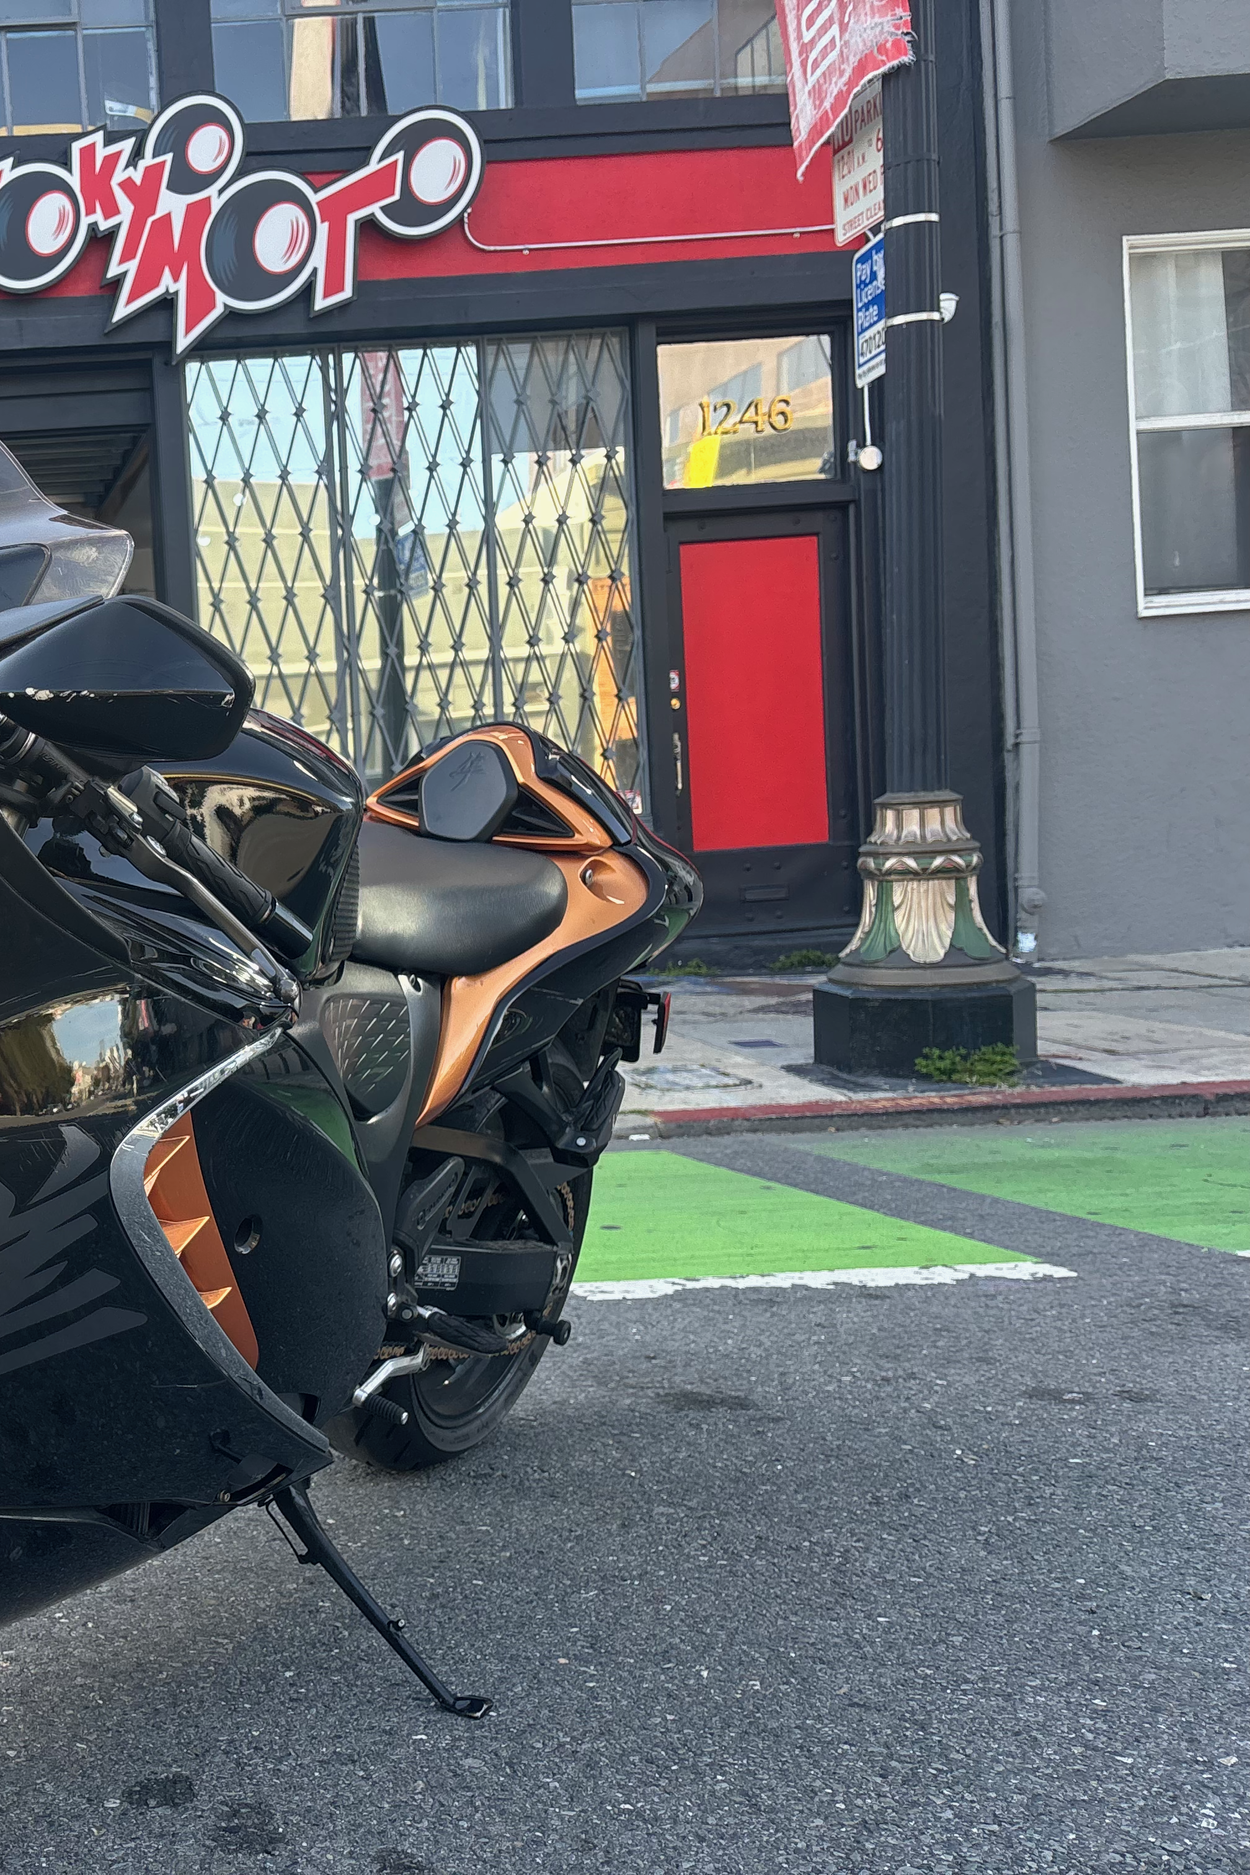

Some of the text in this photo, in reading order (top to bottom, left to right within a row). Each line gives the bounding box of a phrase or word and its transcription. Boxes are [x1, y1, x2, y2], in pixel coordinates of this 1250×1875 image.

[854, 91, 883, 134] PARKI
[842, 181, 860, 211] MON
[861, 169, 878, 198] WED
[106, 106, 485, 357] MOTO
[842, 210, 865, 237] STREET
[857, 258, 872, 284] Pay
[857, 303, 879, 333] Plate
[699, 394, 794, 436] 1246
